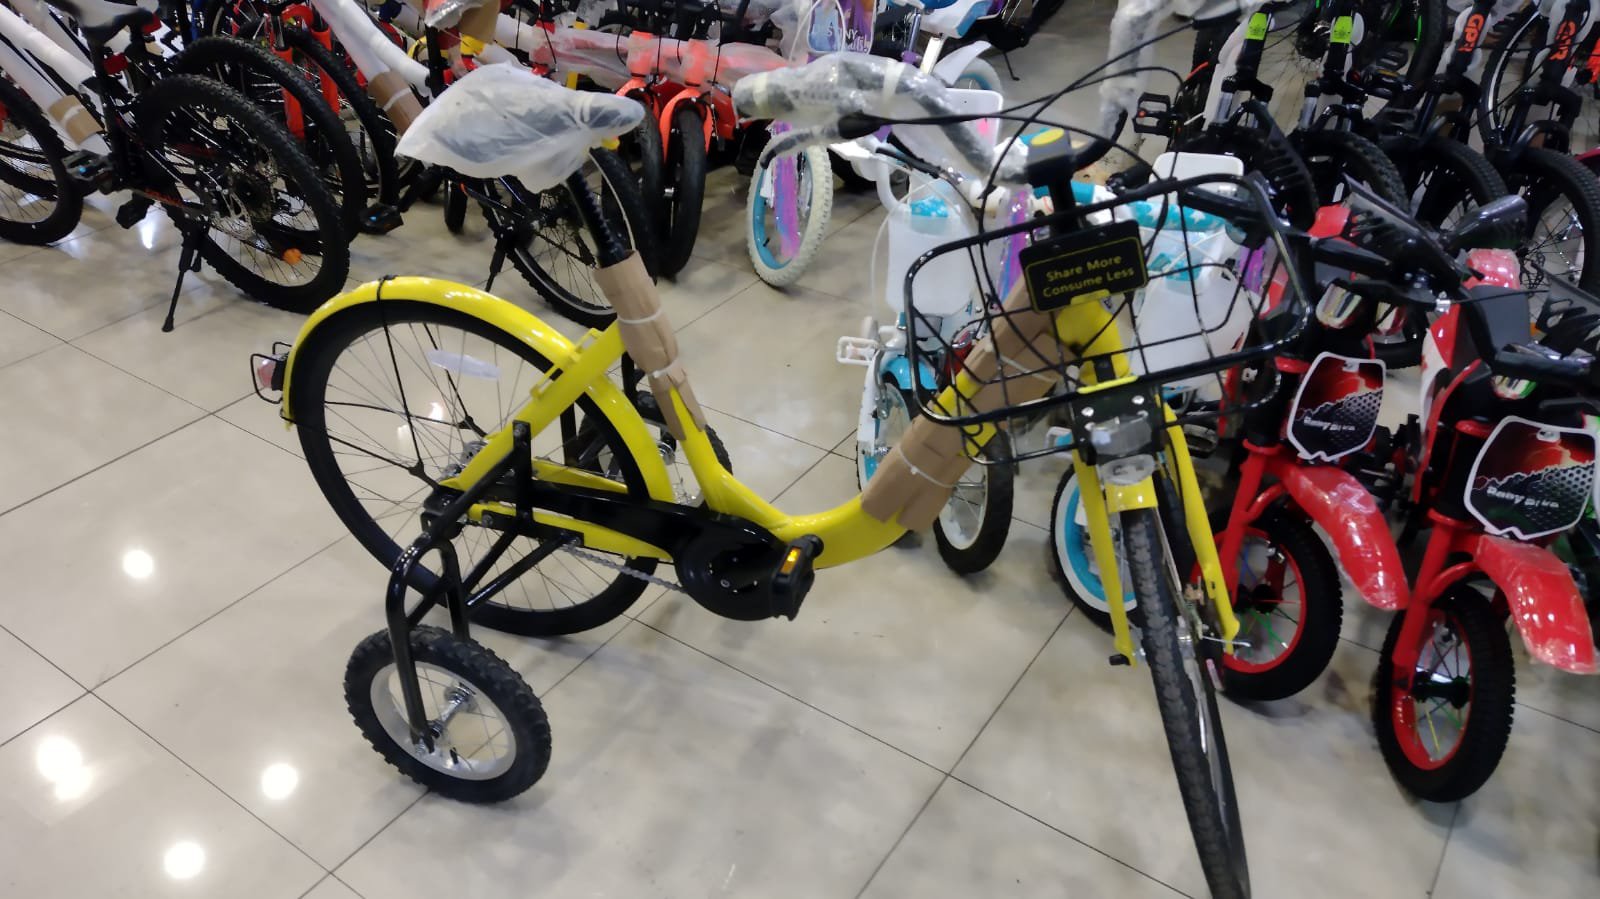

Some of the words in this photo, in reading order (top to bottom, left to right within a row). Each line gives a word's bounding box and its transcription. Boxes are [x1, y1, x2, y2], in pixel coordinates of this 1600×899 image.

[1042, 275, 1103, 298] Consume
[1106, 267, 1135, 281] Less
[1046, 265, 1083, 282] Share
[1086, 255, 1122, 271] More
